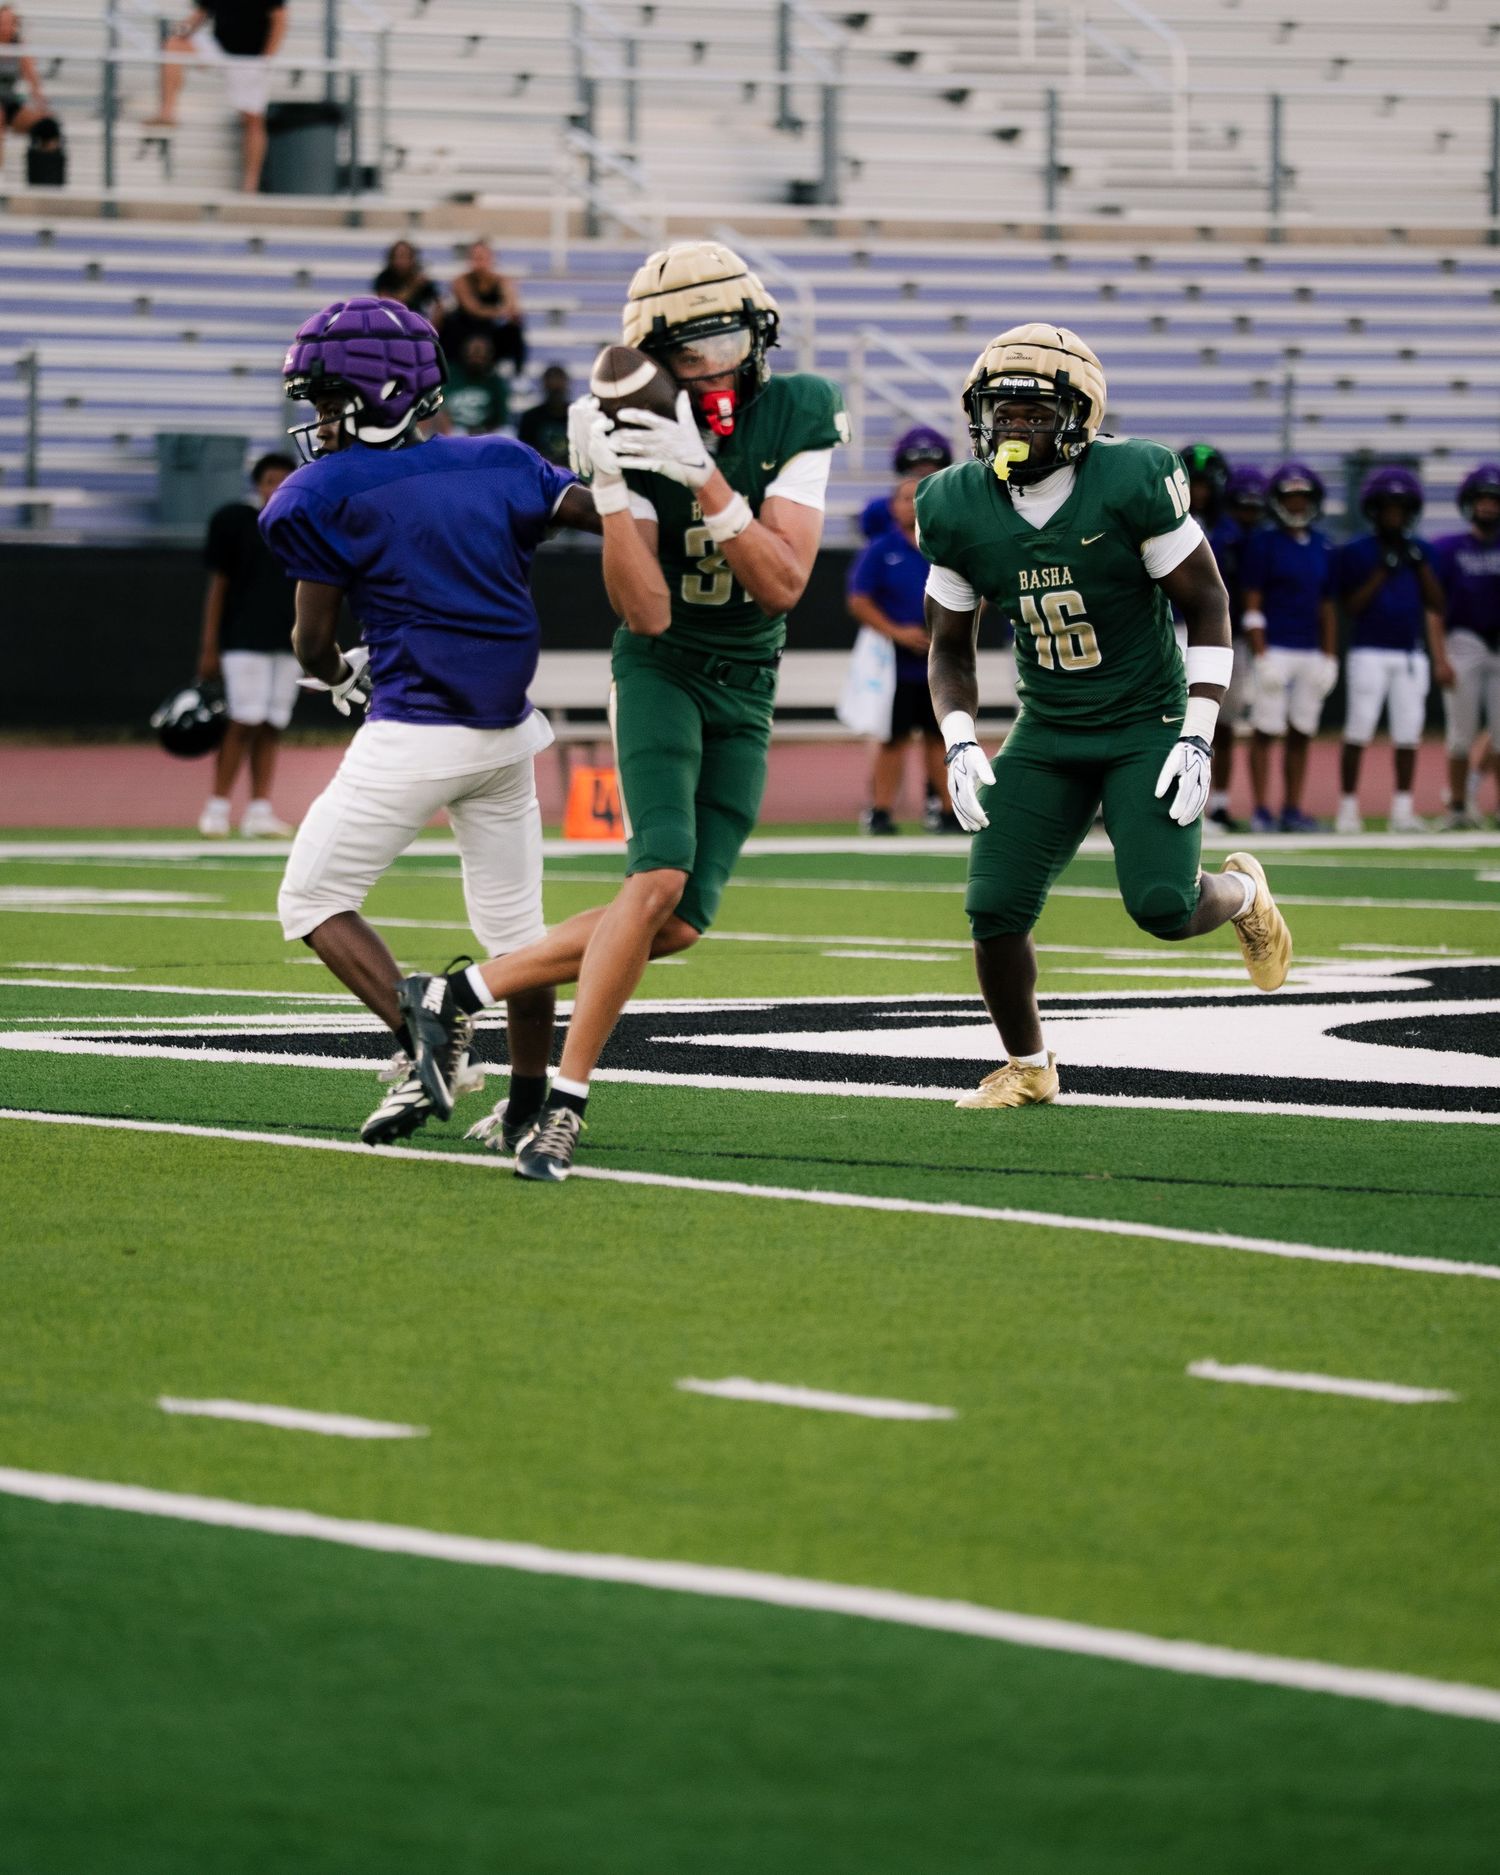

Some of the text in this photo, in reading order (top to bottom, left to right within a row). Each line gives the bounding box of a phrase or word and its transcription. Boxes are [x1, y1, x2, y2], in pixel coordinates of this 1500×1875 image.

[1002, 377, 1035, 388] Riddell
[1164, 467, 1191, 519] 16
[1018, 566, 1074, 591] BASHA
[1019, 590, 1102, 671] 16
